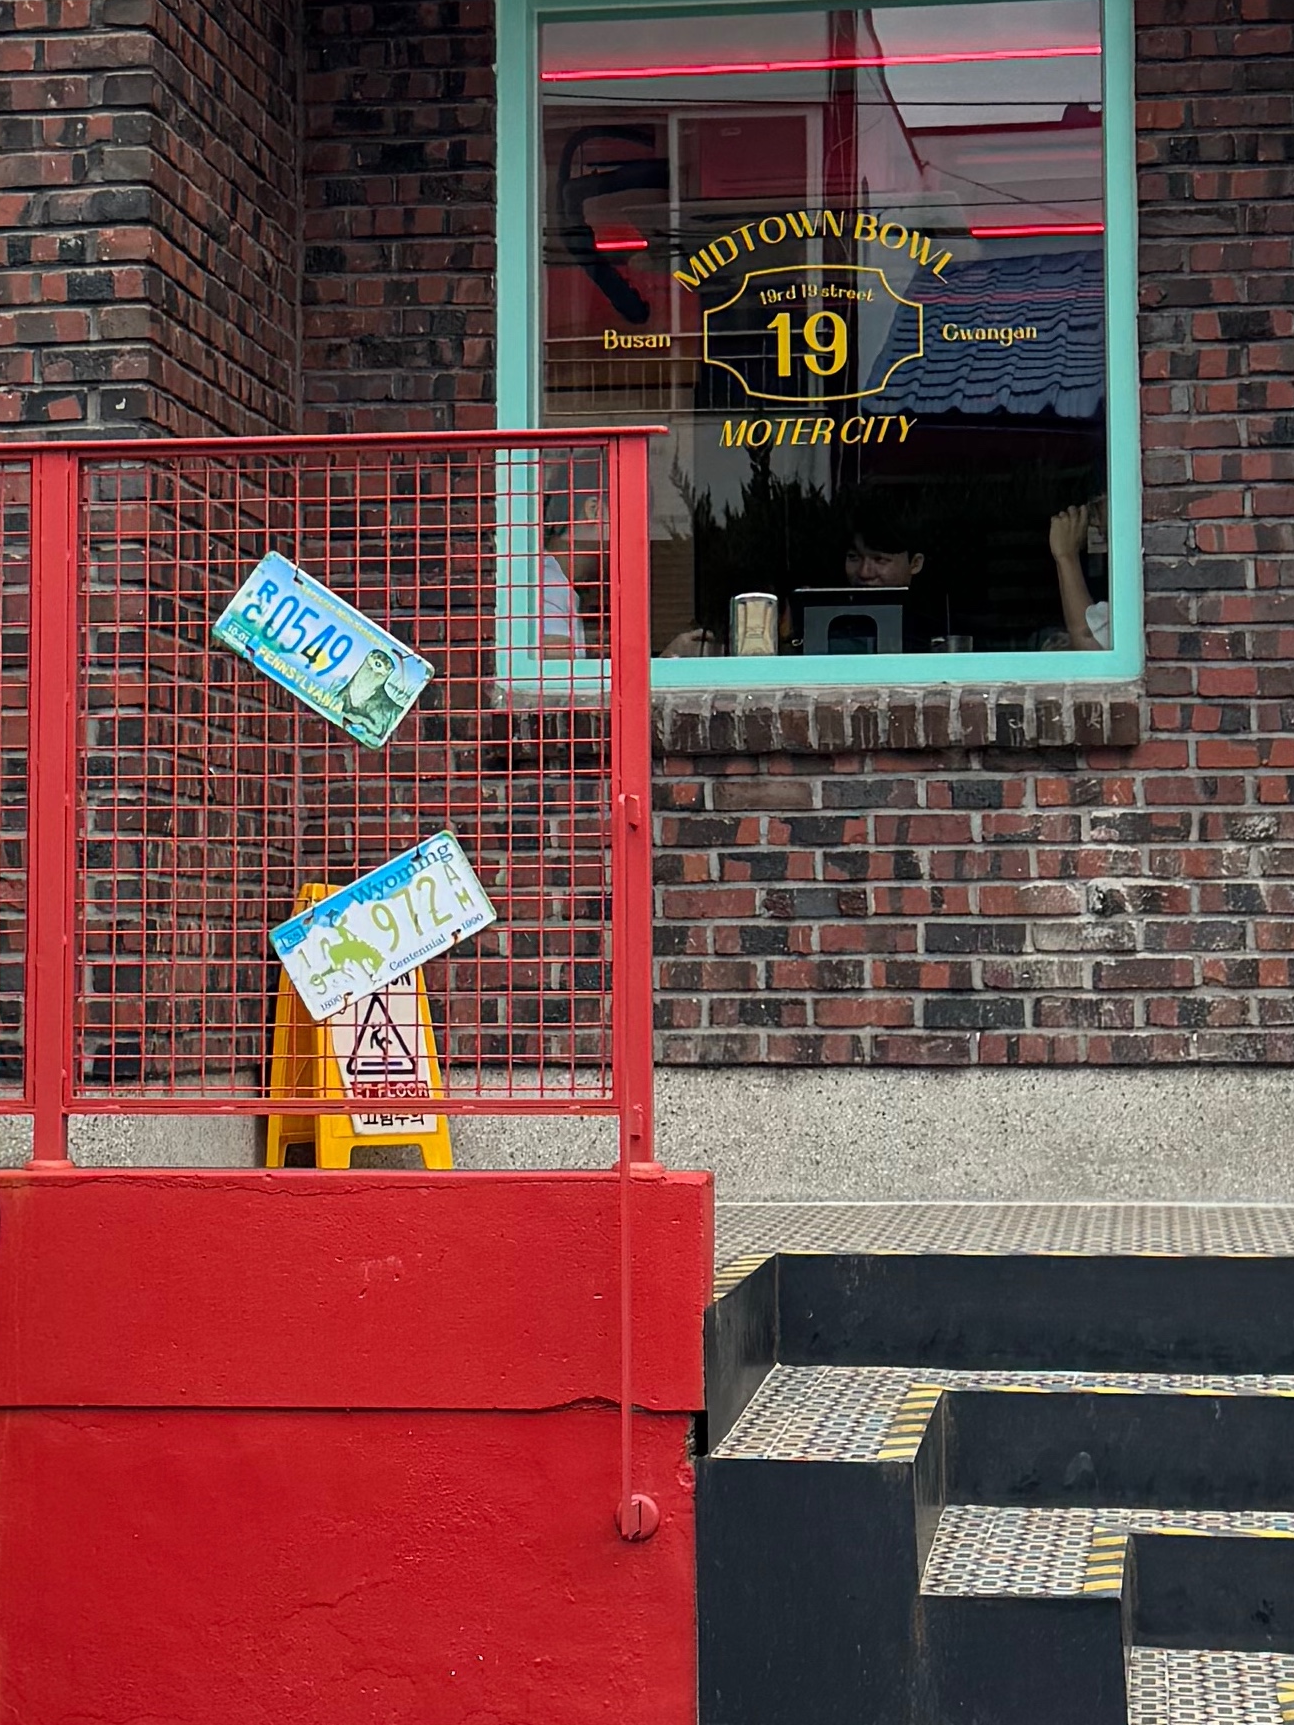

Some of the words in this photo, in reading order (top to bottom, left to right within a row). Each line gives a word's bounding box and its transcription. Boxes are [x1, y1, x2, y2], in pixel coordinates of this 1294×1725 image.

[673, 210, 844, 293] MIDTOWN
[853, 213, 954, 285] BOWL
[759, 283, 796, 306] 19rd
[802, 283, 818, 298] 19
[821, 283, 874, 303] street
[603, 328, 671, 351] Busan
[767, 310, 848, 377] 19
[718, 417, 835, 447] MOTER
[840, 414, 918, 444] CITY
[261, 594, 353, 677] 0549
[257, 646, 345, 714] PENNSYLVANIA
[348, 841, 455, 906] Wyoming
[370, 875, 453, 953] 972
[389, 933, 447, 972] Centennial
[377, 1082, 429, 1098] FLOOR
